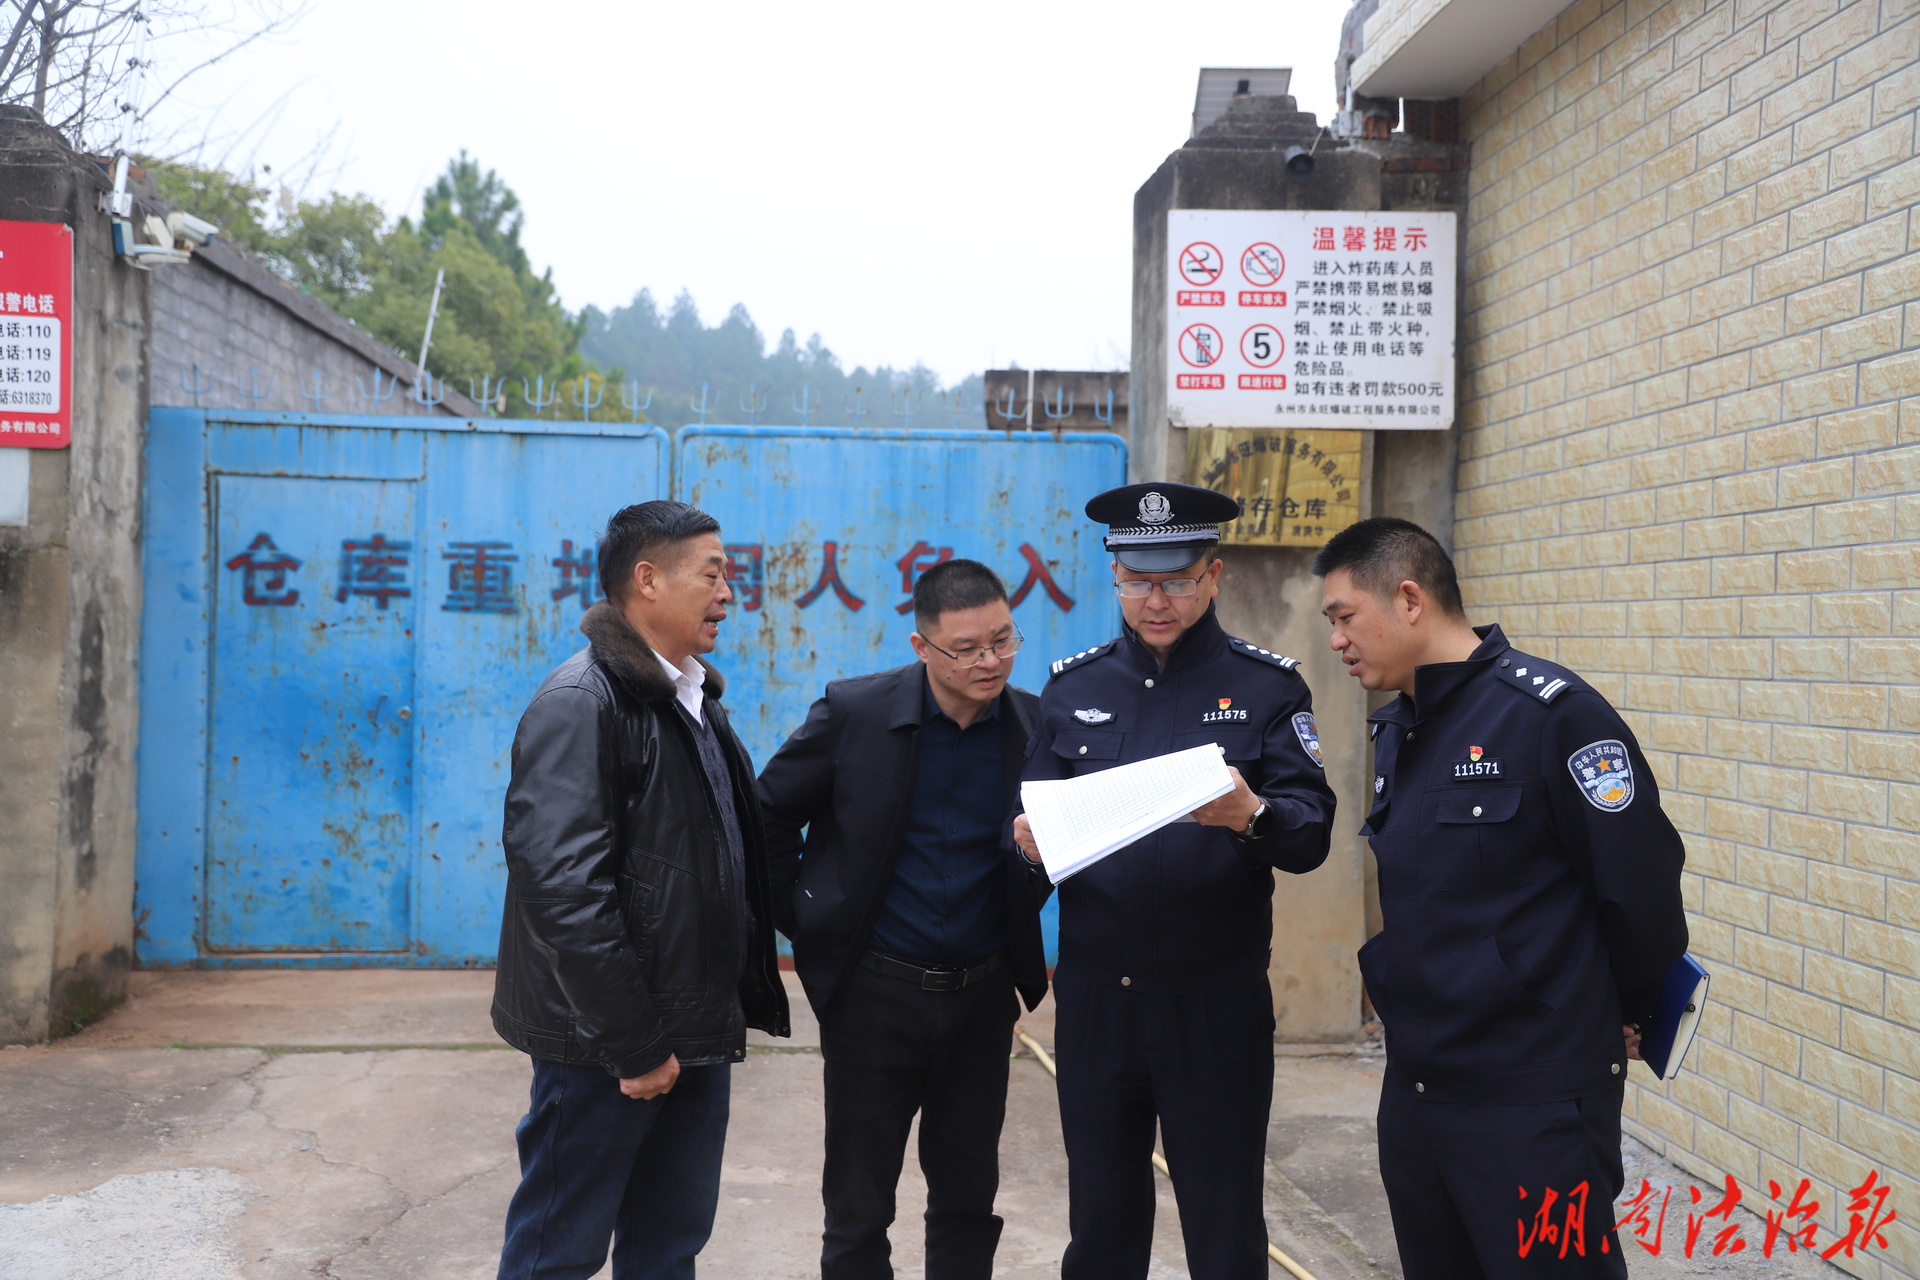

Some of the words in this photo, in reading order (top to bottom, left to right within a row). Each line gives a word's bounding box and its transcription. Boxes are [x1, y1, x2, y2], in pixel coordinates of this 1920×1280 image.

[1312, 226, 1427, 252] 温馨提示
[1313, 260, 1434, 276] 进入炸药库人员
[1295, 280, 1434, 296] 严禁携带易燃易爆
[1180, 292, 1222, 305] 严禁烟火
[1295, 301, 1433, 317] 严禁烟火、禁止吸
[1253, 332, 1271, 360] 5
[1294, 341, 1424, 357] 禁止使用电话等
[1294, 381, 1443, 397] 如有违者罚款500元
[1202, 709, 1247, 722] 111575
[1574, 745, 1623, 770] 中华人民共和国
[1454, 762, 1500, 777] 111571
